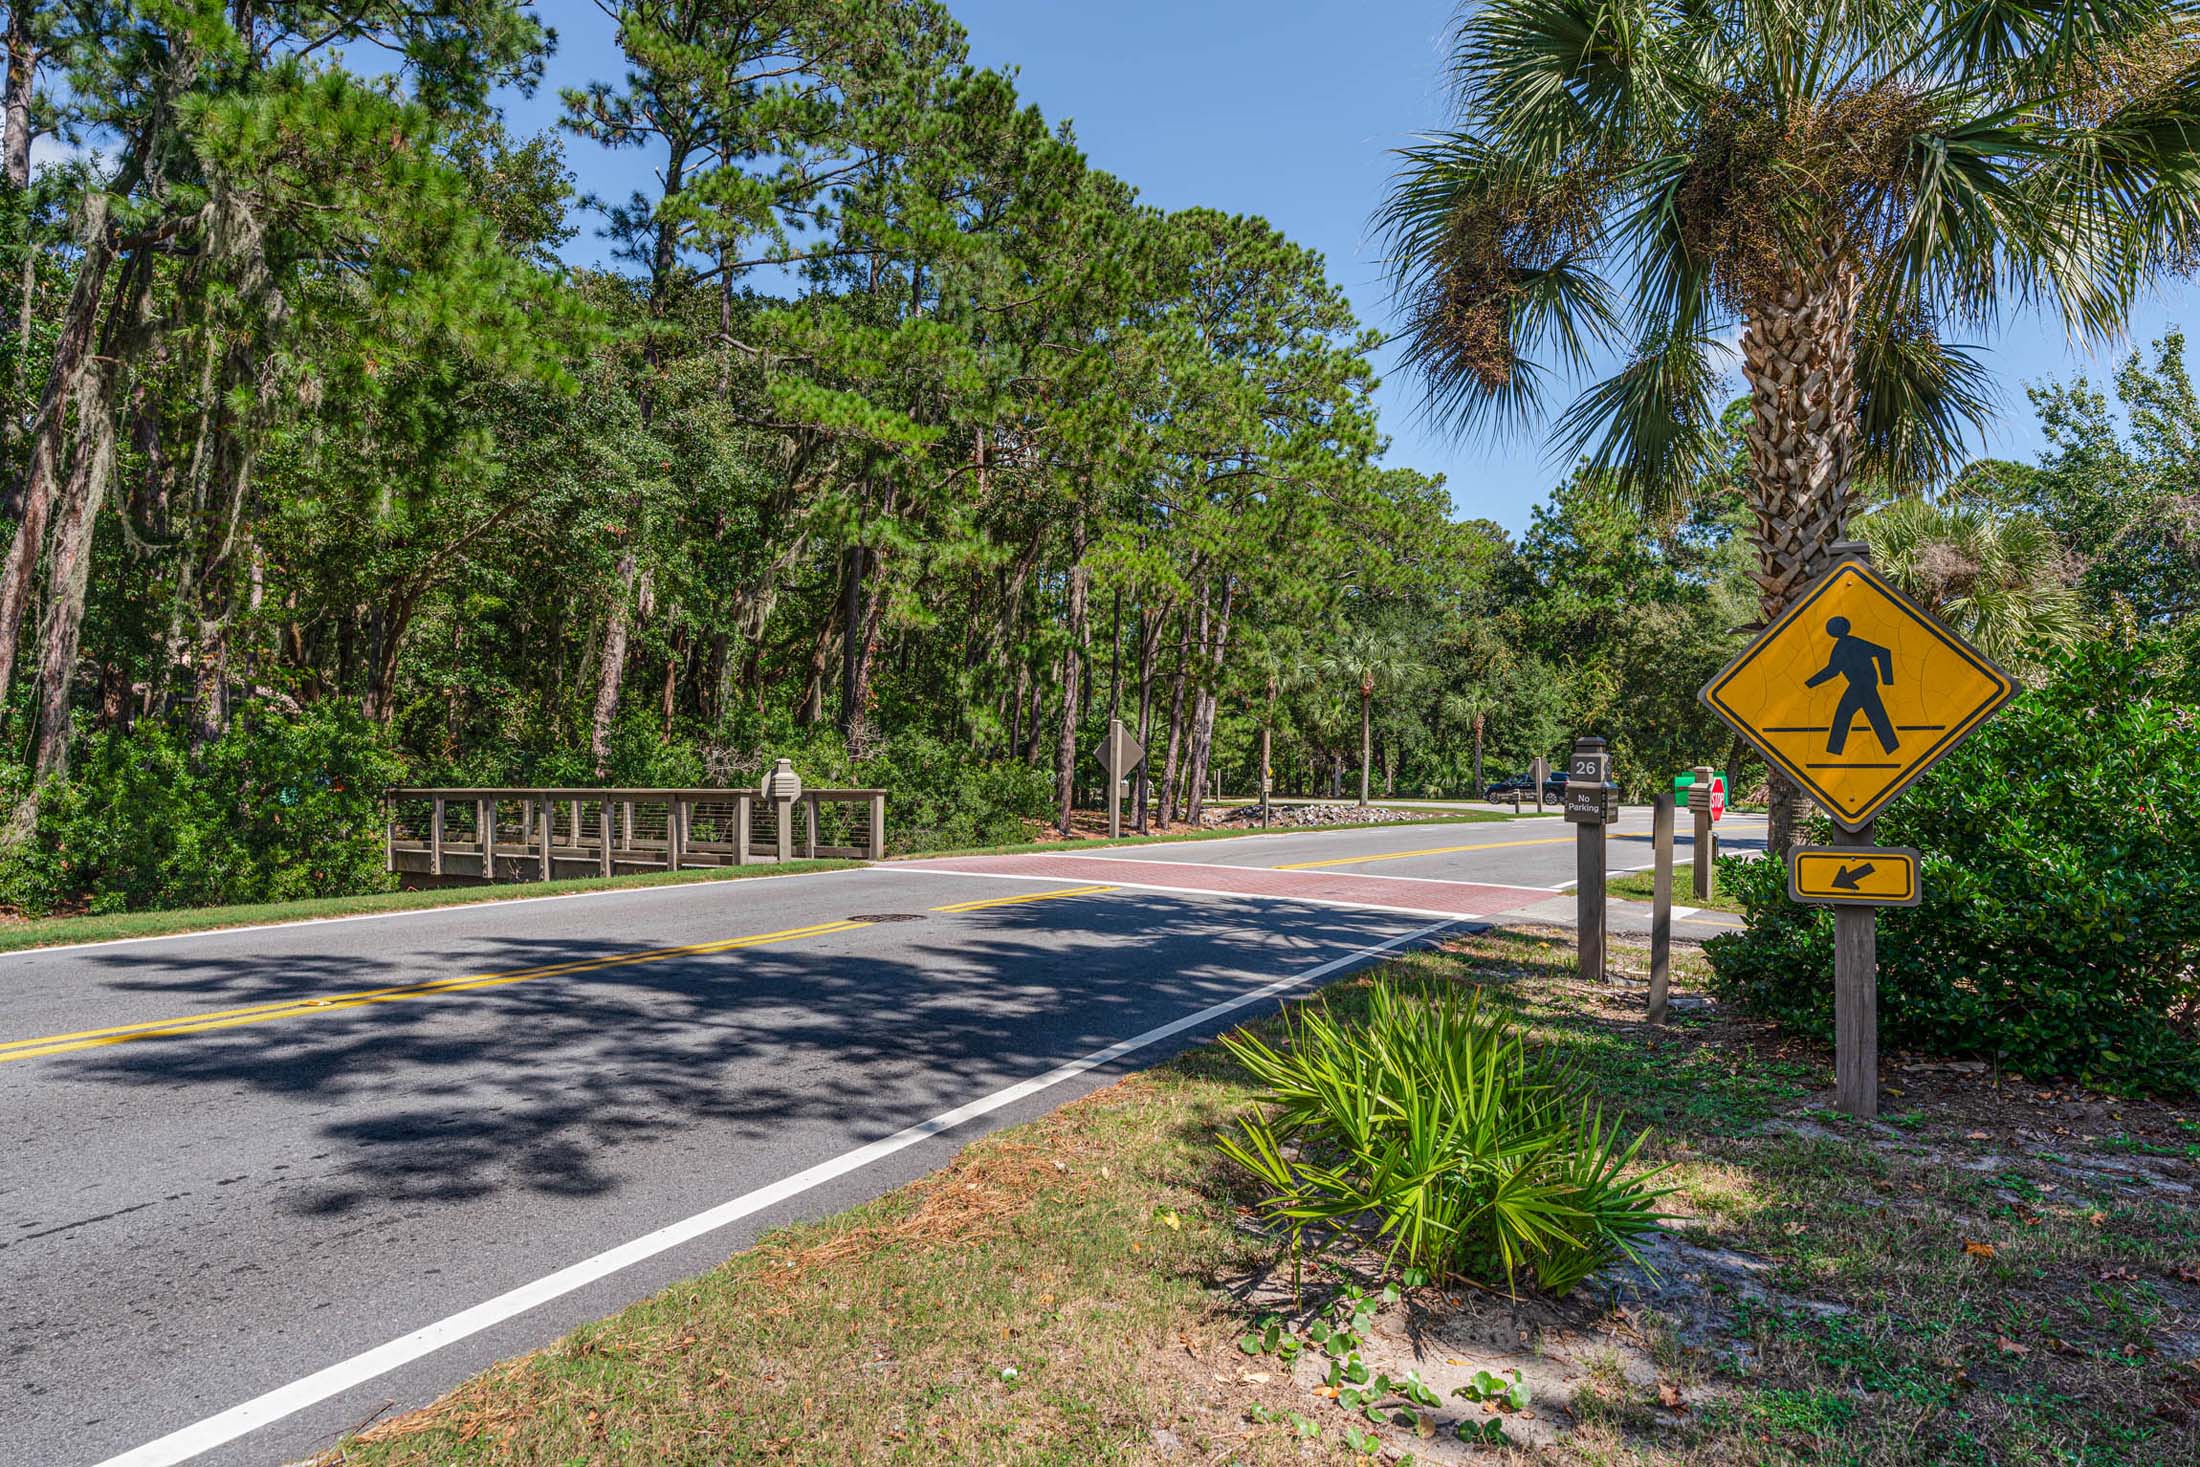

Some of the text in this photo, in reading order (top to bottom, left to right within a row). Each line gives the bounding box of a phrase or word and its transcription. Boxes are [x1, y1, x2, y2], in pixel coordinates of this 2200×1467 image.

[1575, 761, 1596, 775] 26
[1578, 794, 1590, 803] No
[1711, 792, 1724, 808] STOP
[1568, 803, 1599, 813] Parking
